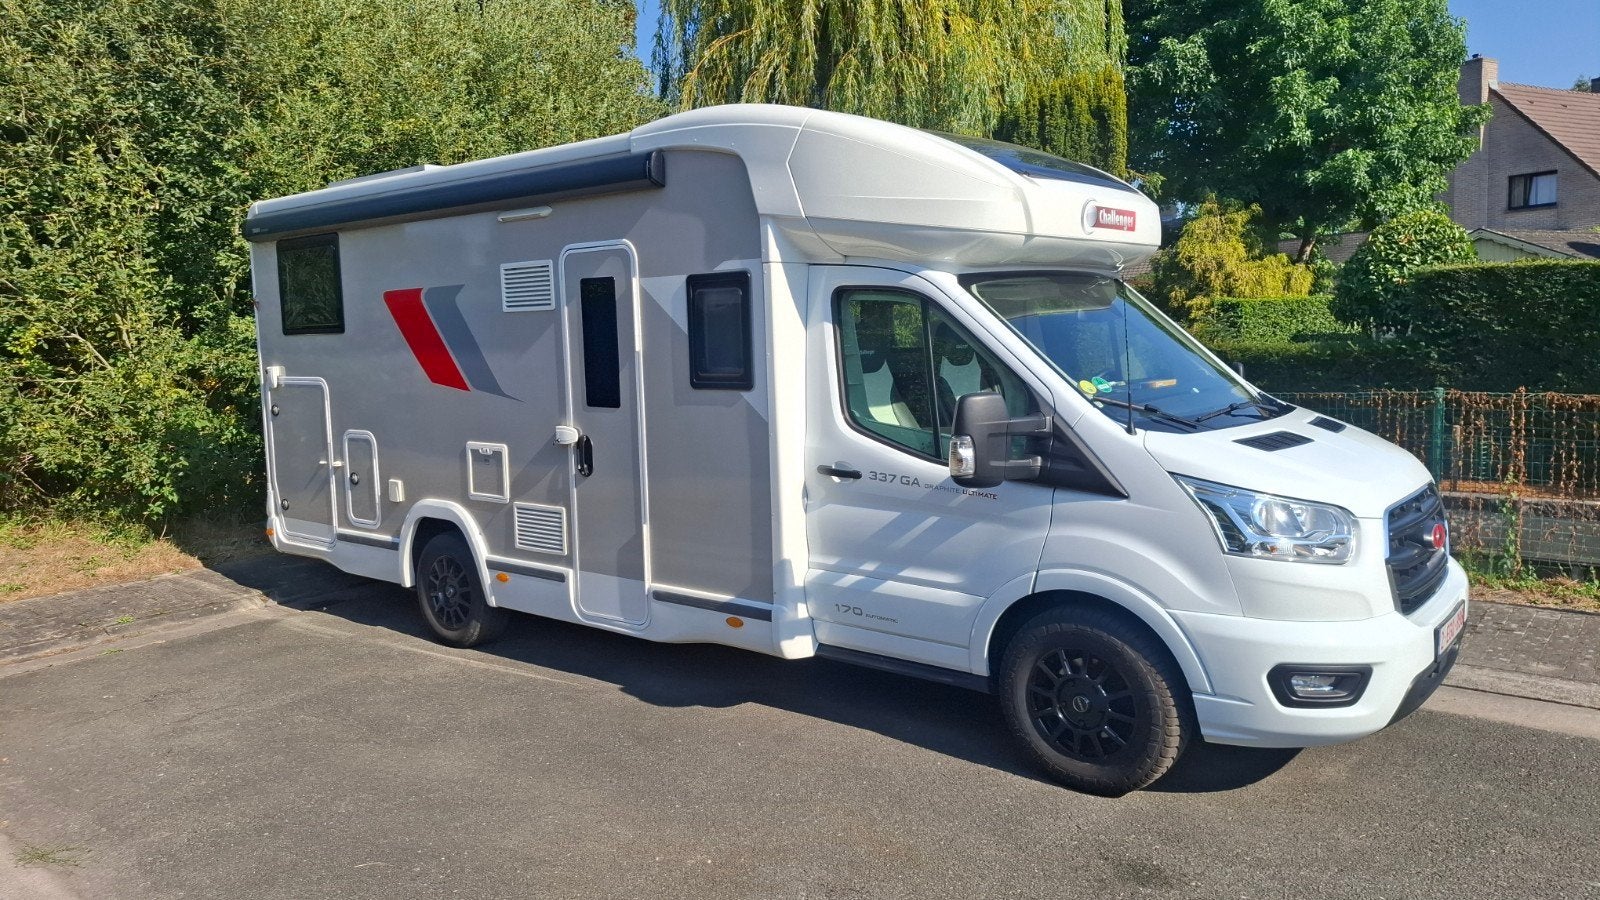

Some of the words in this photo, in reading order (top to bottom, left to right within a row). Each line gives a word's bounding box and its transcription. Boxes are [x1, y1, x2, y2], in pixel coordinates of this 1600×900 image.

[1099, 208, 1134, 231] Challenger
[868, 470, 897, 483] 337
[900, 475, 921, 488] GA
[924, 483, 960, 494] GRAPHITE
[962, 488, 998, 500] ULTIMATE
[835, 603, 863, 616] 170
